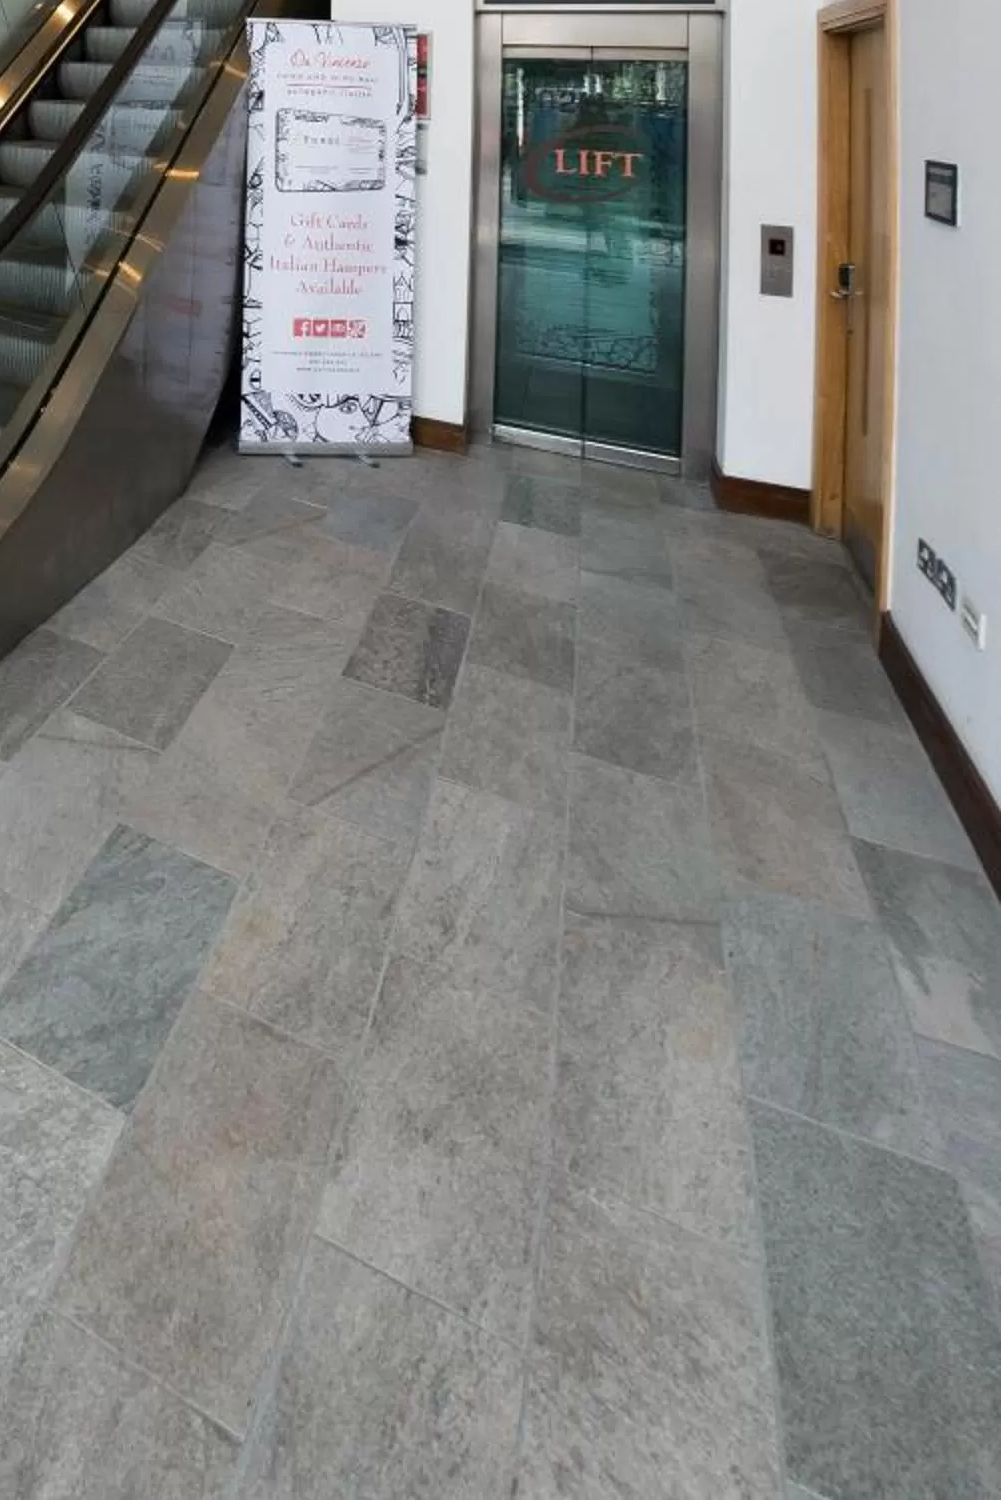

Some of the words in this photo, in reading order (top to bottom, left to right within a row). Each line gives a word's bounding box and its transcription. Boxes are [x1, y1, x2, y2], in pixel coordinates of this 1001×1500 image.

[554, 149, 644, 177] LIFT
[291, 213, 322, 229] Gift
[326, 213, 369, 229] Cards
[303, 232, 375, 252] Authentic
[270, 254, 318, 271] Italian
[323, 257, 388, 276] Hampers
[297, 277, 362, 295] Available
